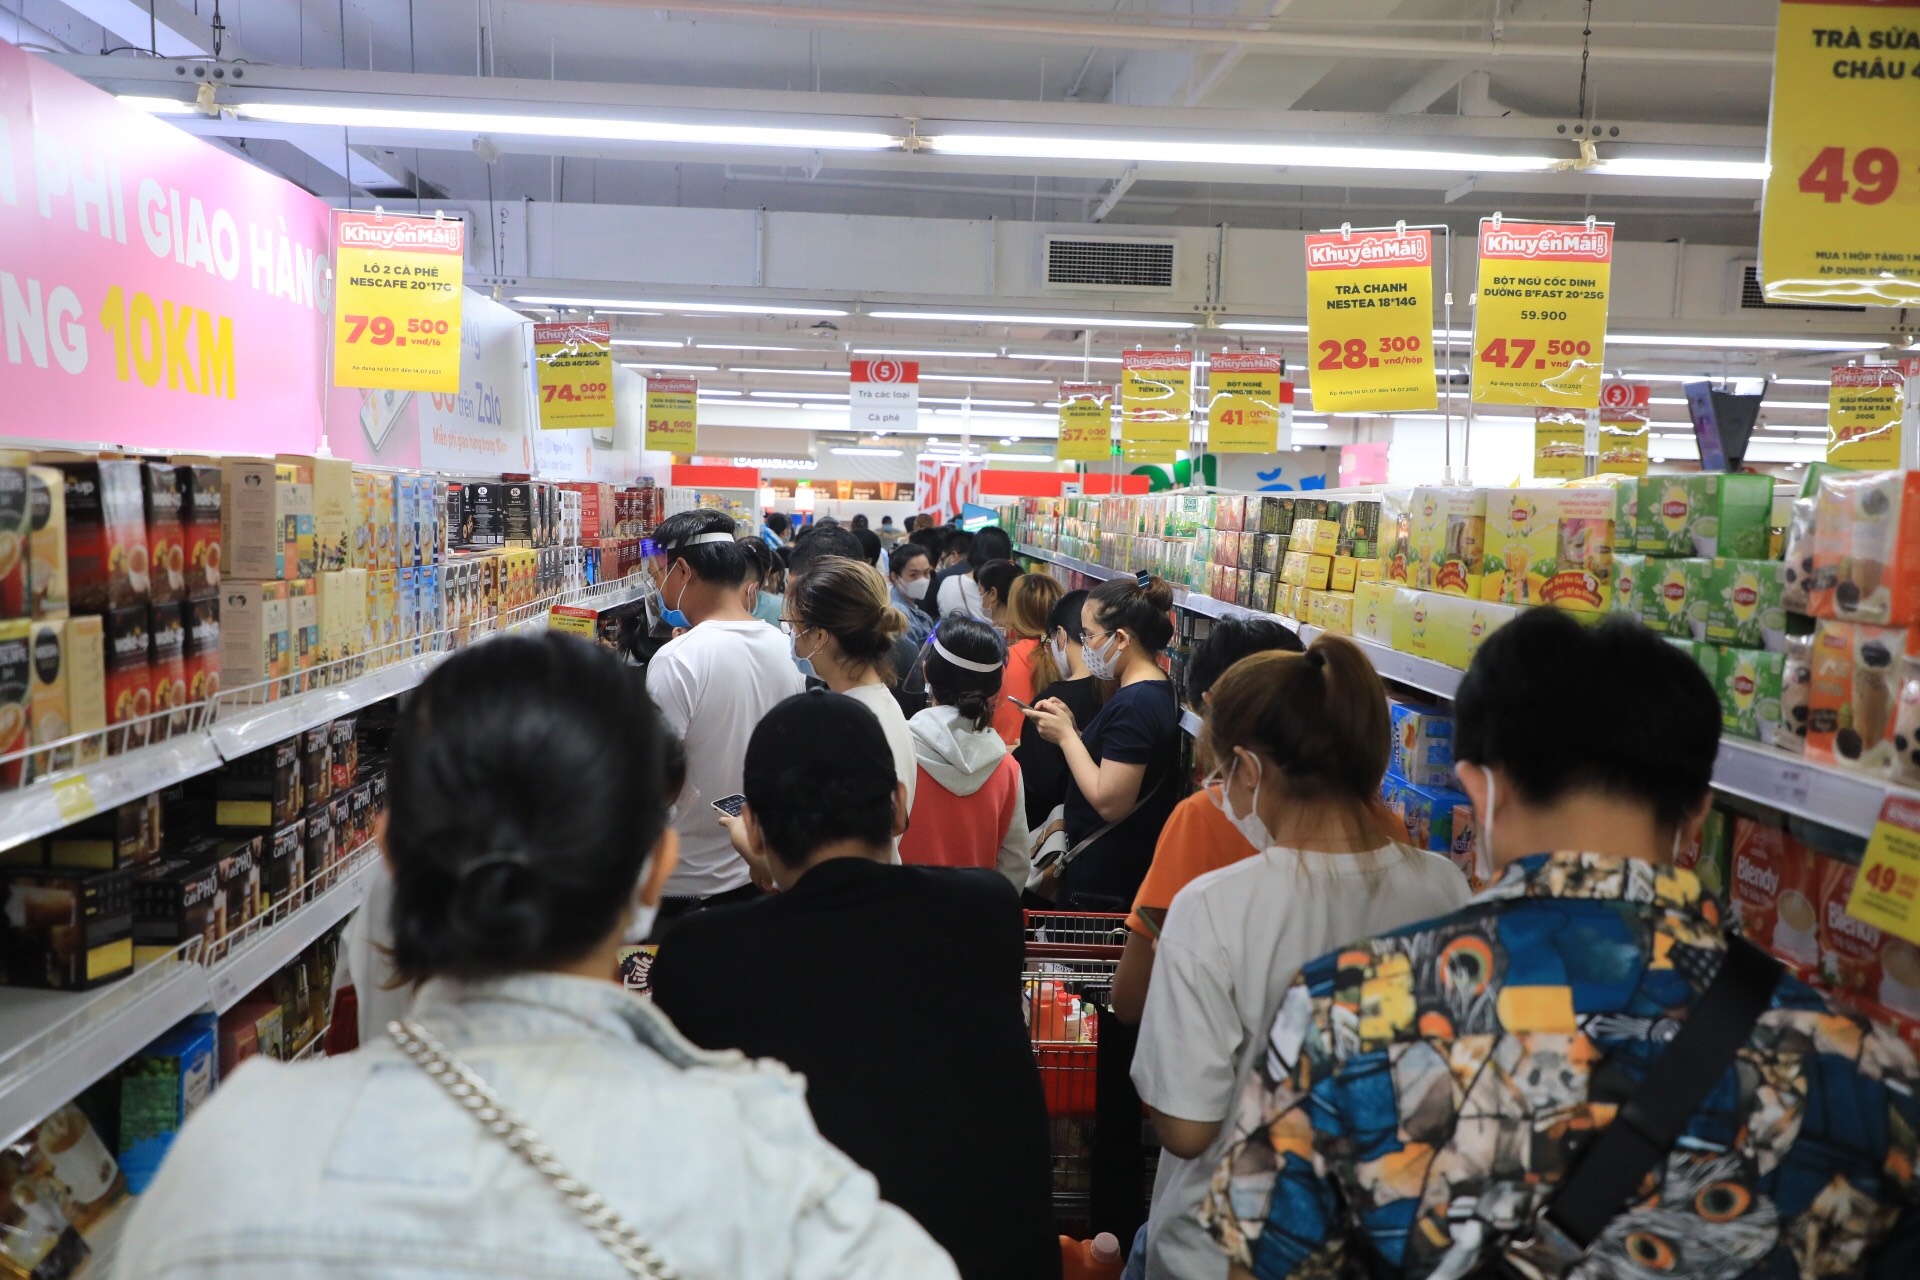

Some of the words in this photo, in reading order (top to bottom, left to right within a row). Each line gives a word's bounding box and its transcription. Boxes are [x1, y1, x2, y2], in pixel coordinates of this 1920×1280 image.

[1812, 27, 1861, 49] TRÀ
[1834, 57, 1906, 79] CHÂU
[138, 178, 241, 281] GIAO
[248, 218, 327, 317] HÀNG
[383, 264, 391, 274] 2
[394, 264, 411, 276] CÀ
[414, 265, 439, 278] PHÊ
[350, 277, 407, 290] NESCAFE
[1335, 283, 1360, 295] TRÀ
[1363, 283, 1408, 294] CHANH
[1494, 276, 1515, 286] BỘT
[1544, 276, 1567, 287] CỐC
[1570, 279, 1596, 288] DINH
[1484, 285, 1522, 297] DƯỠNG
[1326, 299, 1376, 310] NESTEA
[1521, 310, 1567, 321] 59.900
[407, 318, 449, 335] 500
[100, 284, 236, 401] 10KM
[1379, 336, 1420, 352] 300
[1547, 339, 1591, 356] 500
[880, 365, 890, 378] 5
[858, 390, 872, 398] Trà
[874, 391, 891, 399] các
[475, 381, 502, 426] Zalo
[1220, 409, 1243, 426] 41
[1664, 503, 1686, 516] Lipton
